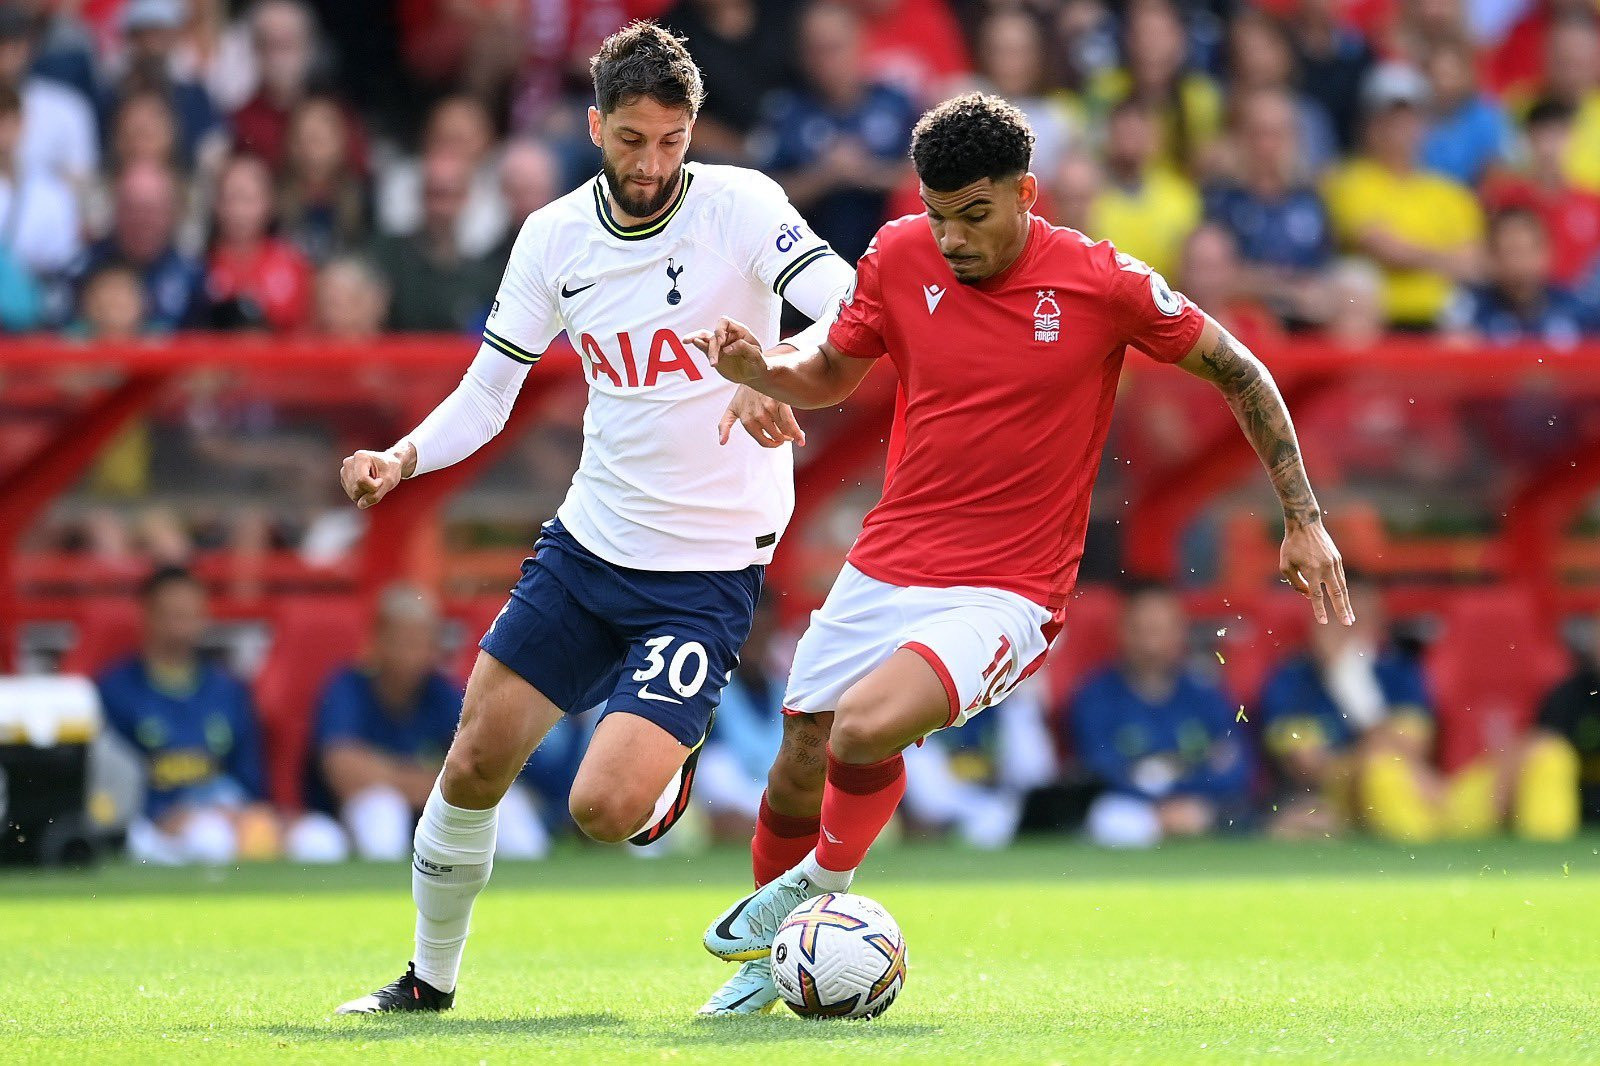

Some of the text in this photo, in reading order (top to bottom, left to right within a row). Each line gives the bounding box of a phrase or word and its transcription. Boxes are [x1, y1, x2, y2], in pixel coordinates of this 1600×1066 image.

[581, 328, 703, 387] AIA
[632, 635, 709, 698] 30
[415, 853, 453, 873] URS
